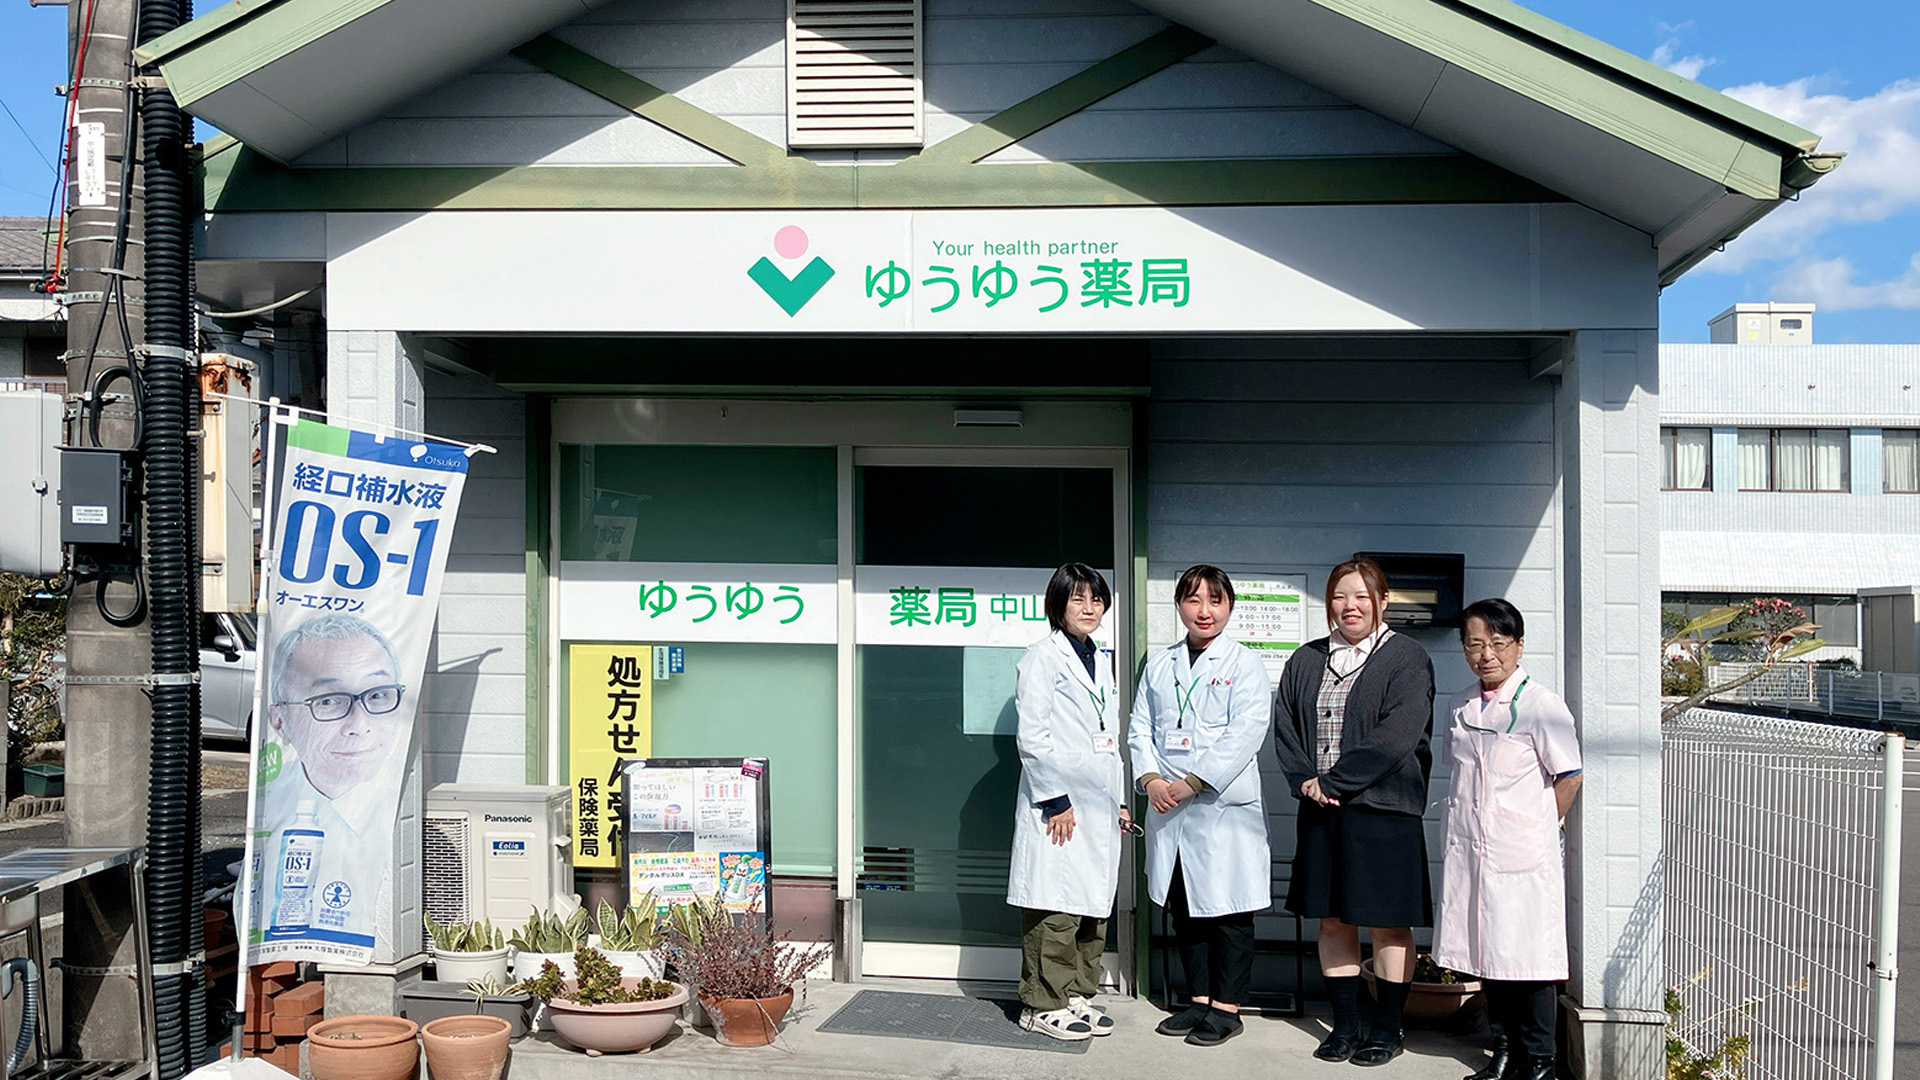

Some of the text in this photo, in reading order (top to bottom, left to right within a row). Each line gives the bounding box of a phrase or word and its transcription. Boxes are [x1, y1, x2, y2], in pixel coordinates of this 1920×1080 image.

[932, 239, 1119, 257] Your health partner
[864, 257, 1191, 314] ゆうゆう薬局
[424, 455, 461, 468] Otsuka
[292, 462, 448, 510] 経口補水液
[279, 499, 440, 597] OS-1
[275, 590, 365, 614] オーエスワン
[638, 579, 804, 625] ゆうゆう
[889, 586, 976, 627] 薬局
[484, 814, 533, 823] Panasonic
[578, 777, 600, 858] 保険薬局
[498, 842, 520, 850] Eolia
[285, 856, 311, 871] OS-1
